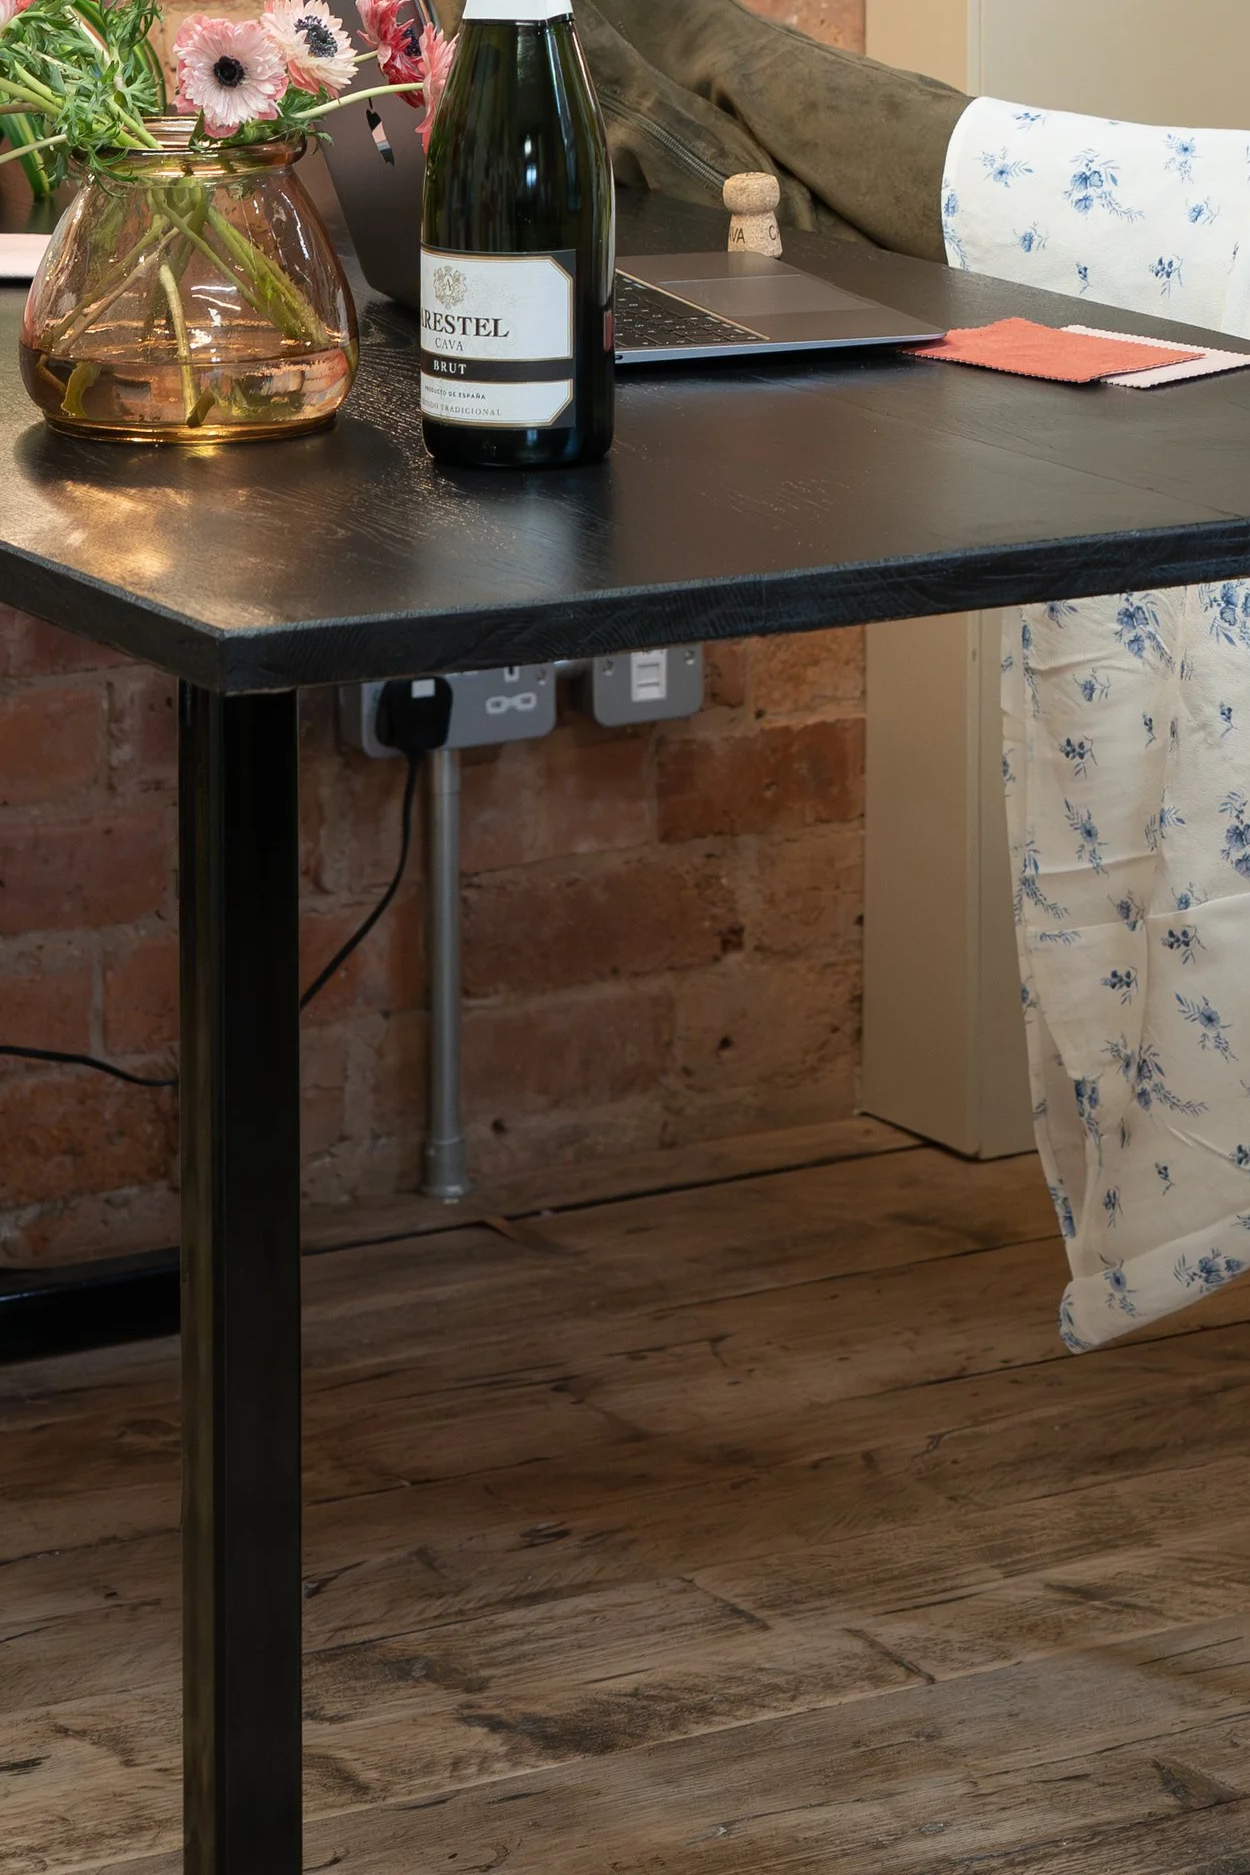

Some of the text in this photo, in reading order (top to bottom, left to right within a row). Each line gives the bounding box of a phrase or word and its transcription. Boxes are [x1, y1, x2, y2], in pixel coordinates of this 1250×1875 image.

[434, 337, 464, 351] CAVA
[433, 359, 467, 375] BRUT
[457, 392, 486, 401] ESPAÑA
[440, 403, 502, 416] TRADICIONAL
